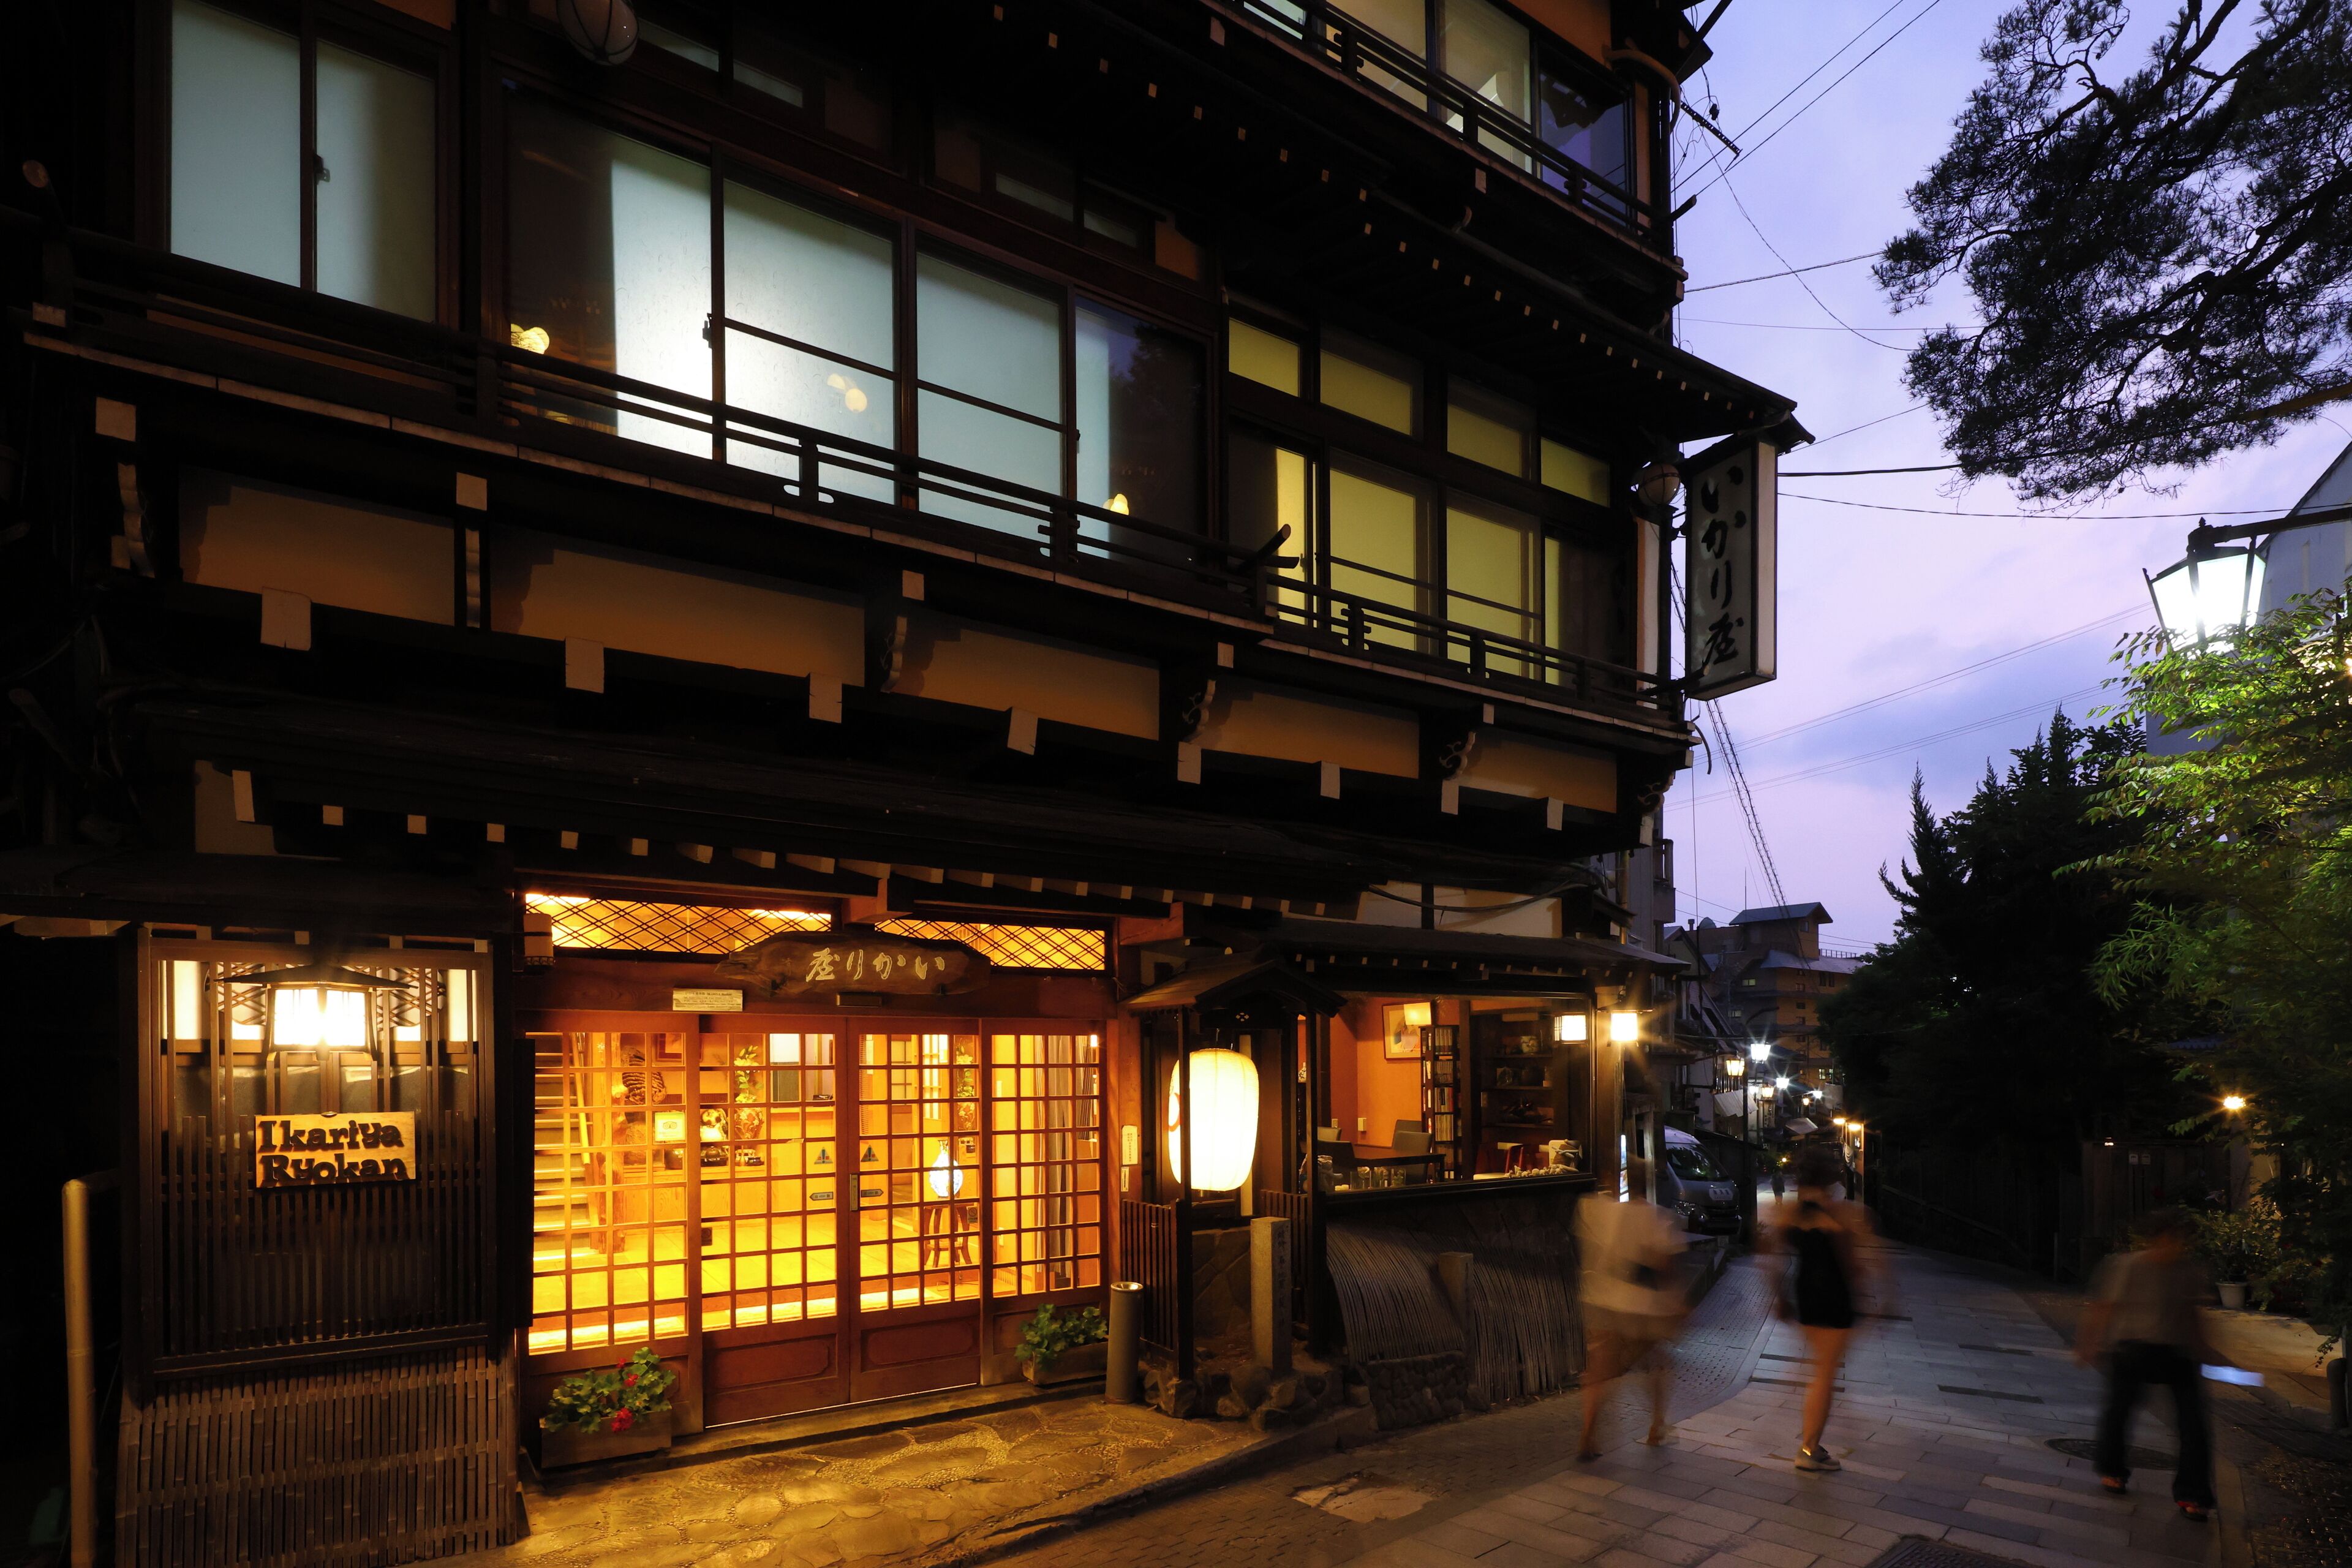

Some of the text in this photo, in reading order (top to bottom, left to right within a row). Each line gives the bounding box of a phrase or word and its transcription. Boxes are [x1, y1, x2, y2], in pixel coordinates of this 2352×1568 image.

[1700, 464, 1745, 665] いかり屋
[806, 948, 946, 982] いかり屋
[258, 1120, 405, 1153] Ikariya
[259, 1153, 410, 1186] Ryokan
